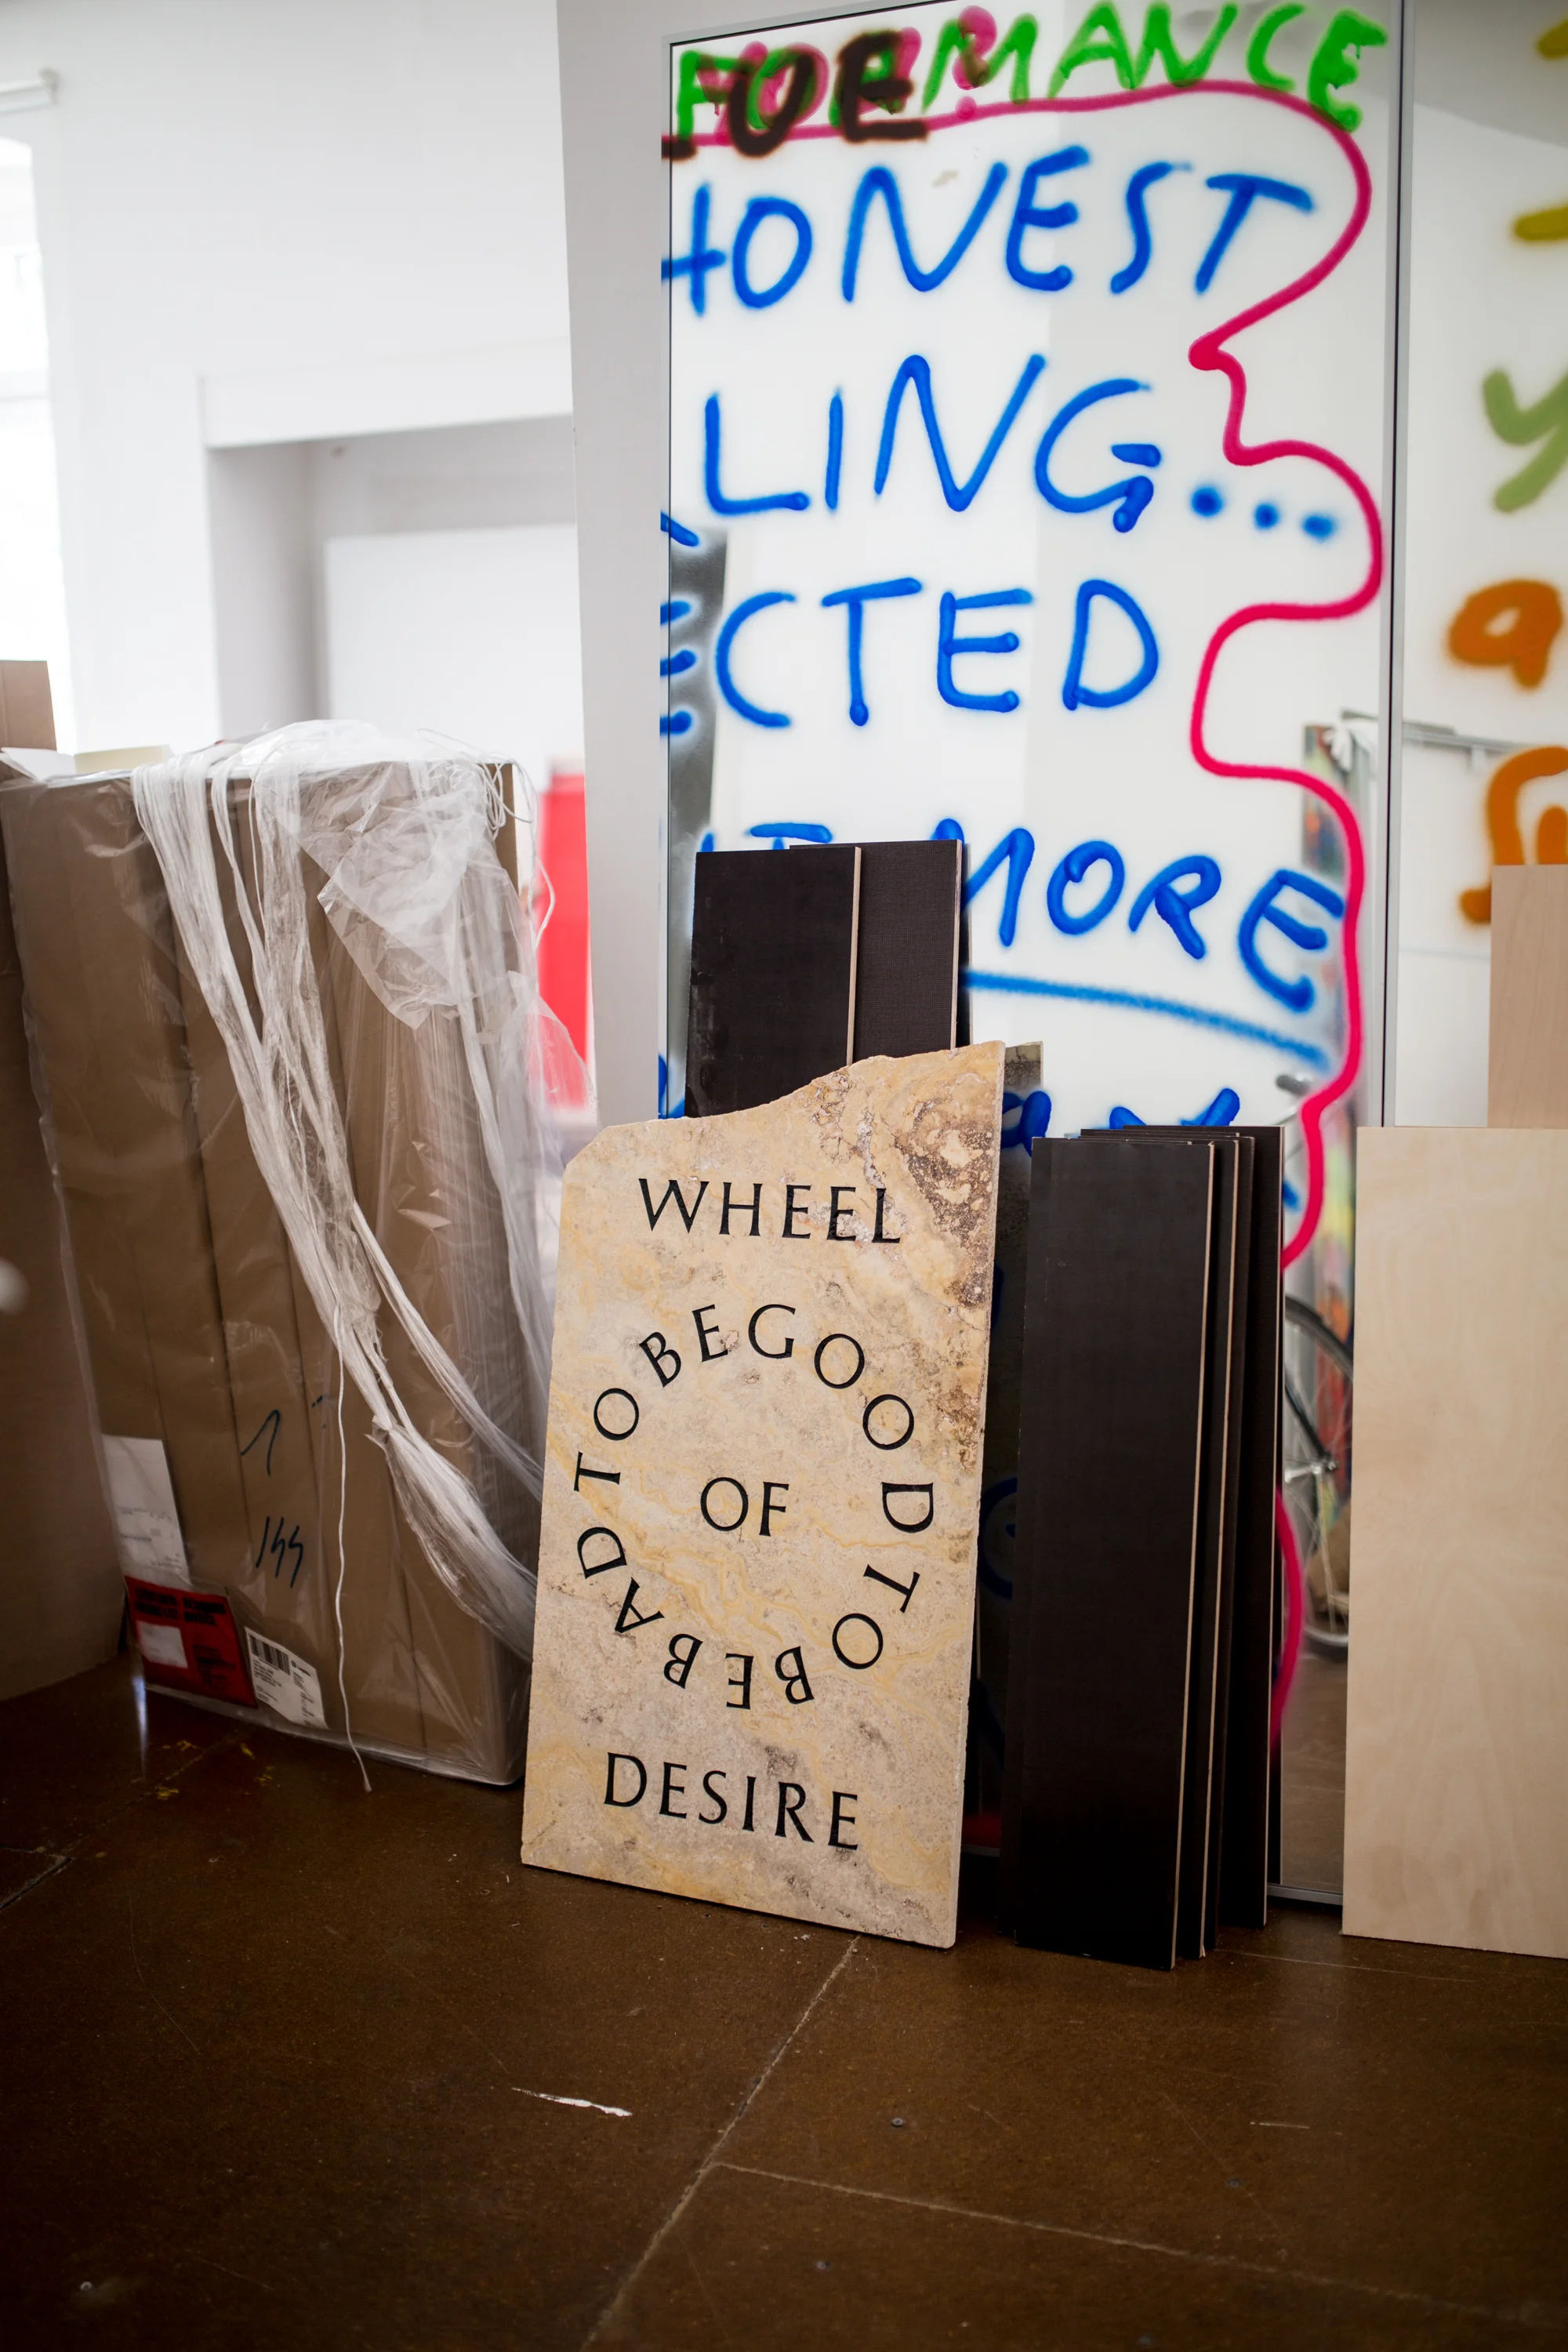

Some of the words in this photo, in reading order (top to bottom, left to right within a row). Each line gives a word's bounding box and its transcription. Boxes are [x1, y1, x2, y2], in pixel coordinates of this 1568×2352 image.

[660, 354, 1336, 547] LING...
[638, 1178, 901, 1243] WHEEL
[700, 1476, 789, 1537] OF
[604, 1751, 858, 1851] DESIRE
